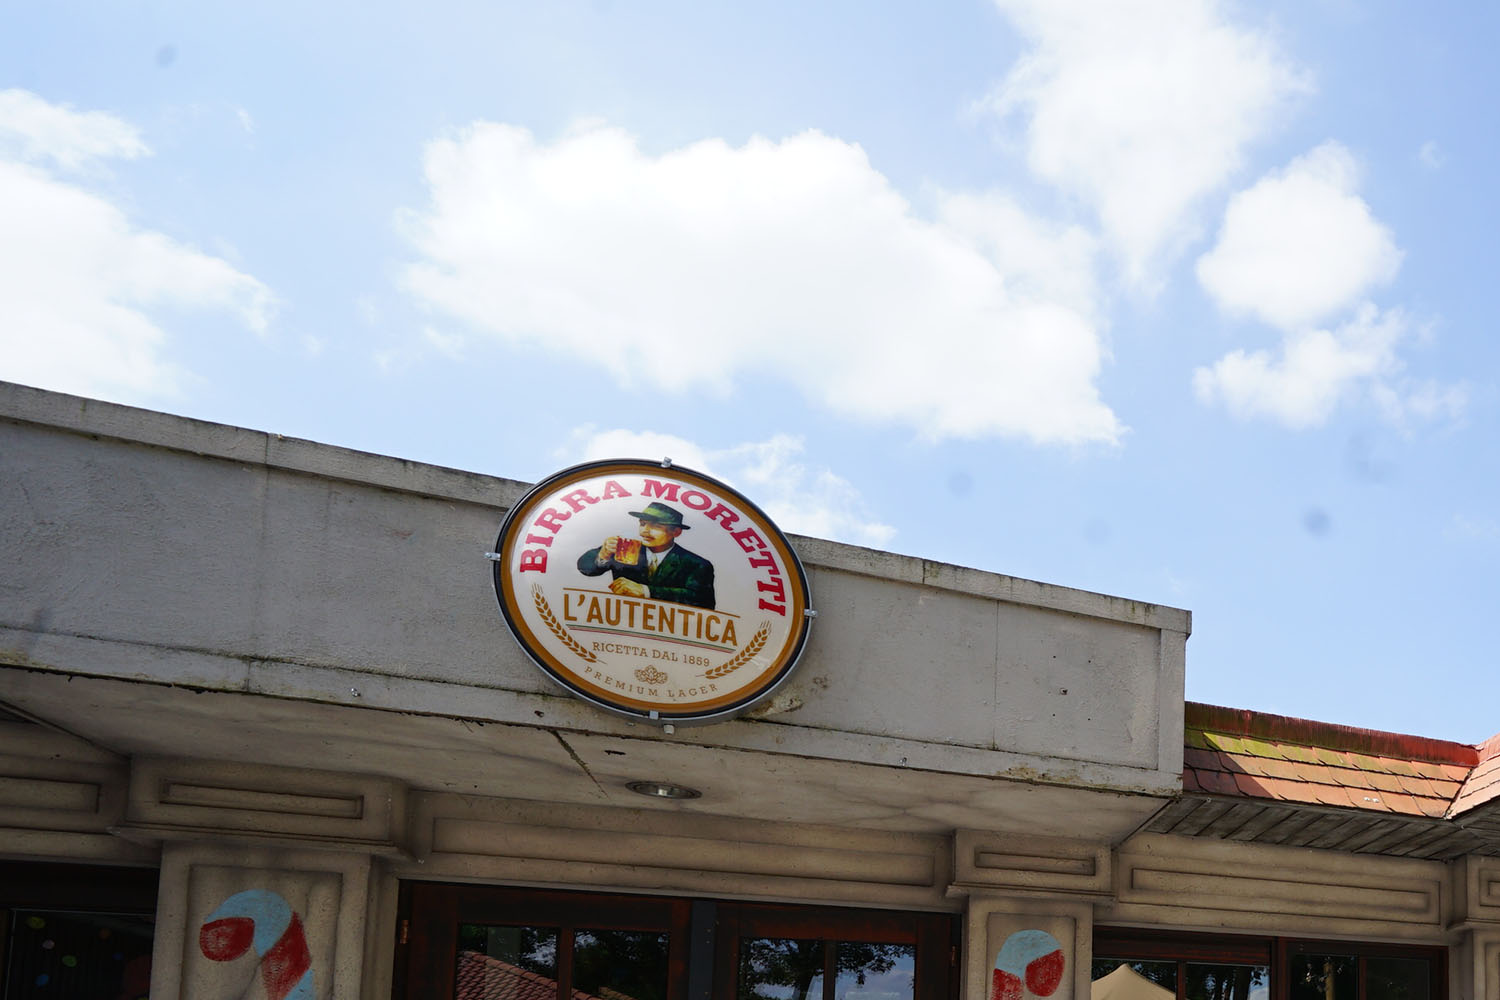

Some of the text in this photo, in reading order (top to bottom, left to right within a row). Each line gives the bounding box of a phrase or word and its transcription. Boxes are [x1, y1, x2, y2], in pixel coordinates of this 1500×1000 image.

[520, 479, 786, 616] BIRRA MORETTI
[563, 594, 738, 647] L'AUTENTICA
[592, 642, 710, 667] RICETTA DAL 1859
[585, 666, 718, 698] PREMIUM LAGER
